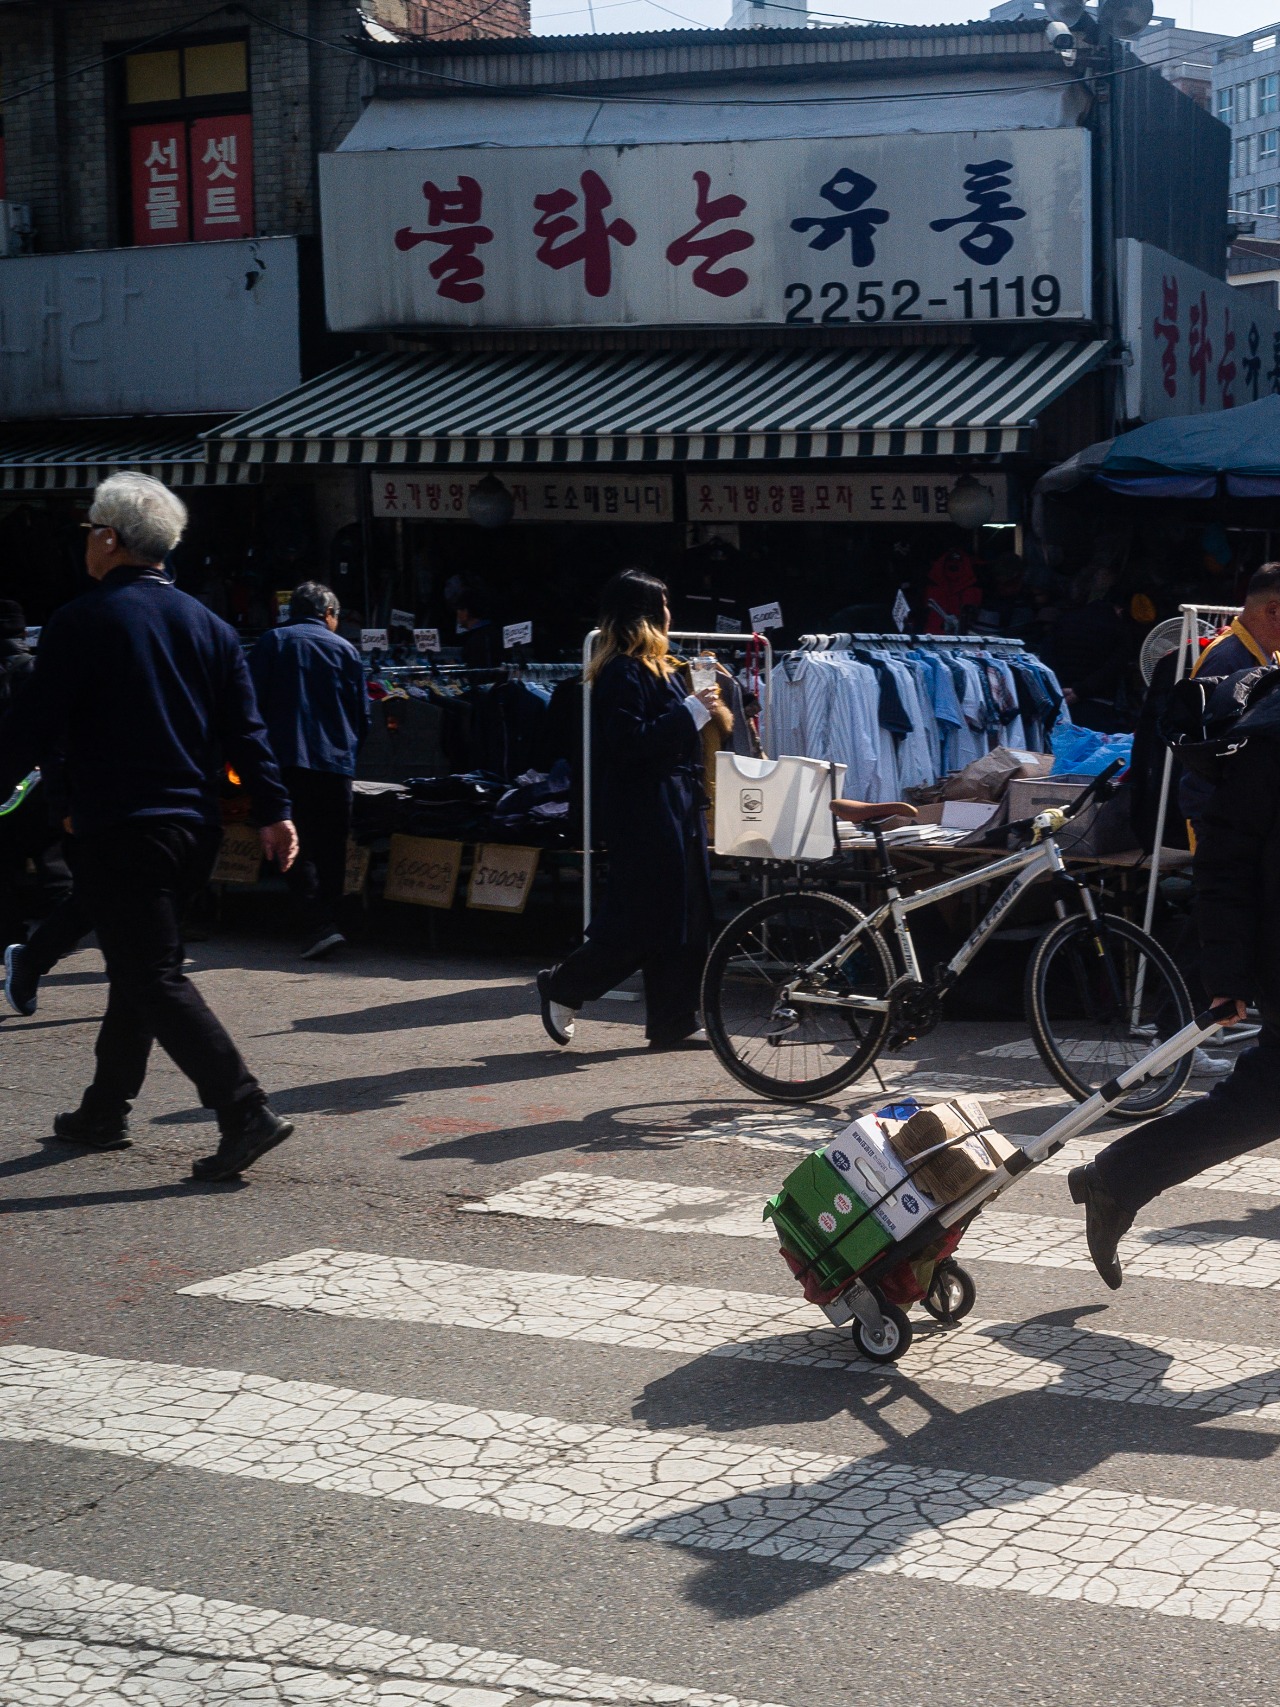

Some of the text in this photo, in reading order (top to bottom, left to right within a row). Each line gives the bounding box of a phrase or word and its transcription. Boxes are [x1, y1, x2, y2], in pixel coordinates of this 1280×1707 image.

[144, 138, 181, 230] 선물
[201, 135, 241, 225] 셋트
[394, 158, 1027, 304] 불타는 유통
[784, 273, 1062, 324] 2252-1119
[1154, 272, 1237, 409] 불타는
[544, 485, 662, 514] 도소매합니다
